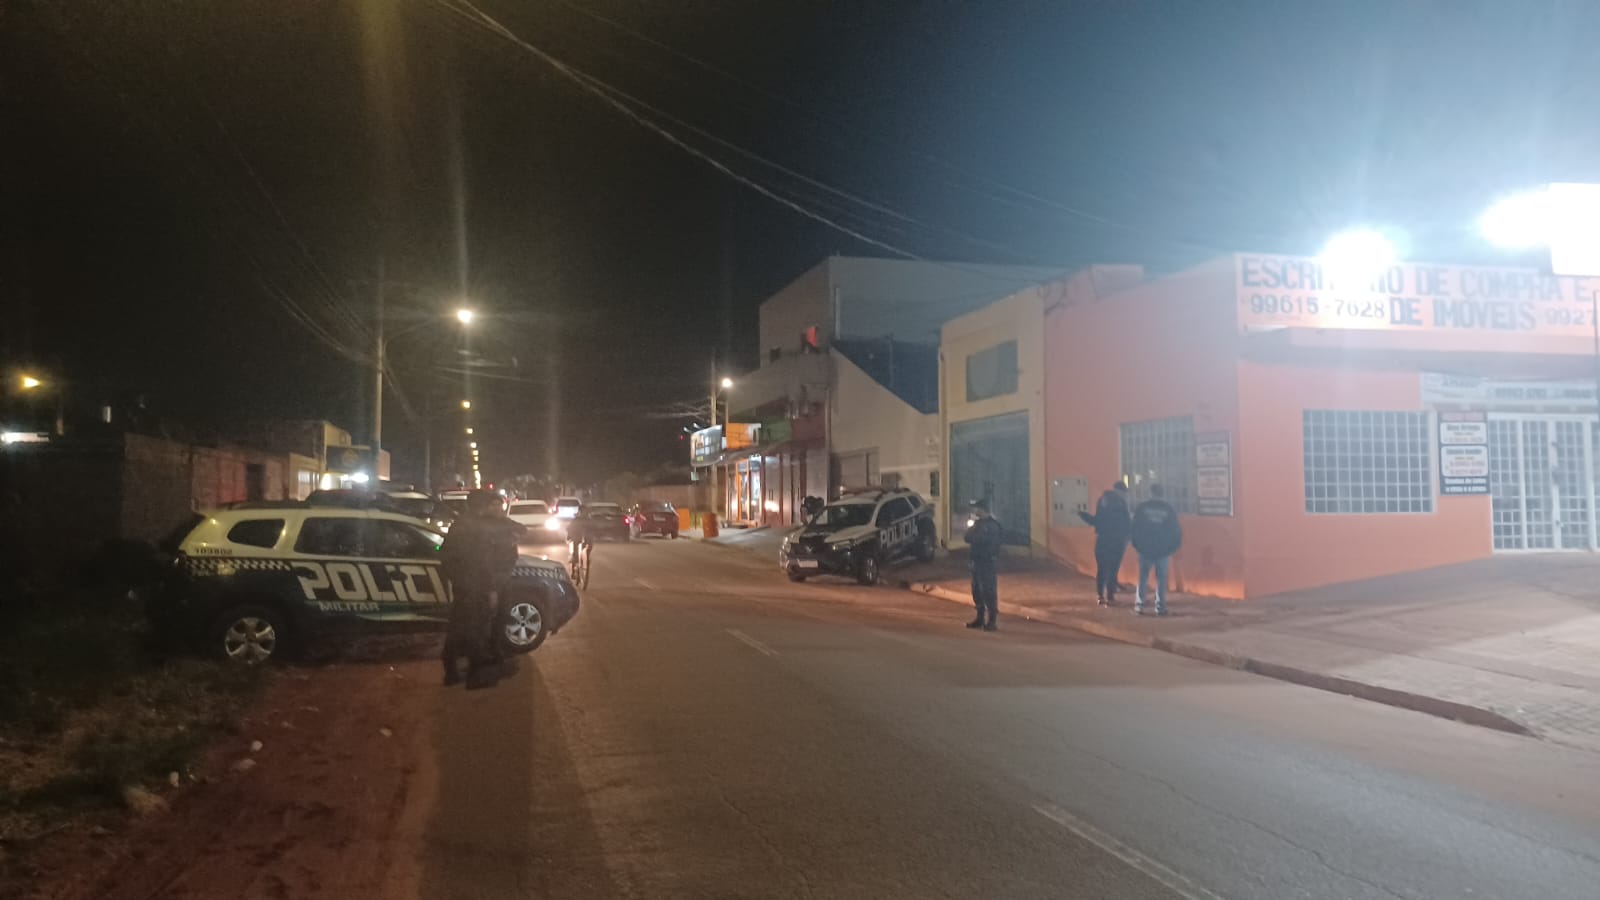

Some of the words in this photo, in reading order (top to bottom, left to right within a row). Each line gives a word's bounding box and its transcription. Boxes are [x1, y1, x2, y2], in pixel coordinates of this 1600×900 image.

[1416, 267, 1449, 296] DE
[1390, 297, 1422, 326] DE
[290, 560, 453, 602] POLICI
[318, 600, 380, 612] MILITAR
